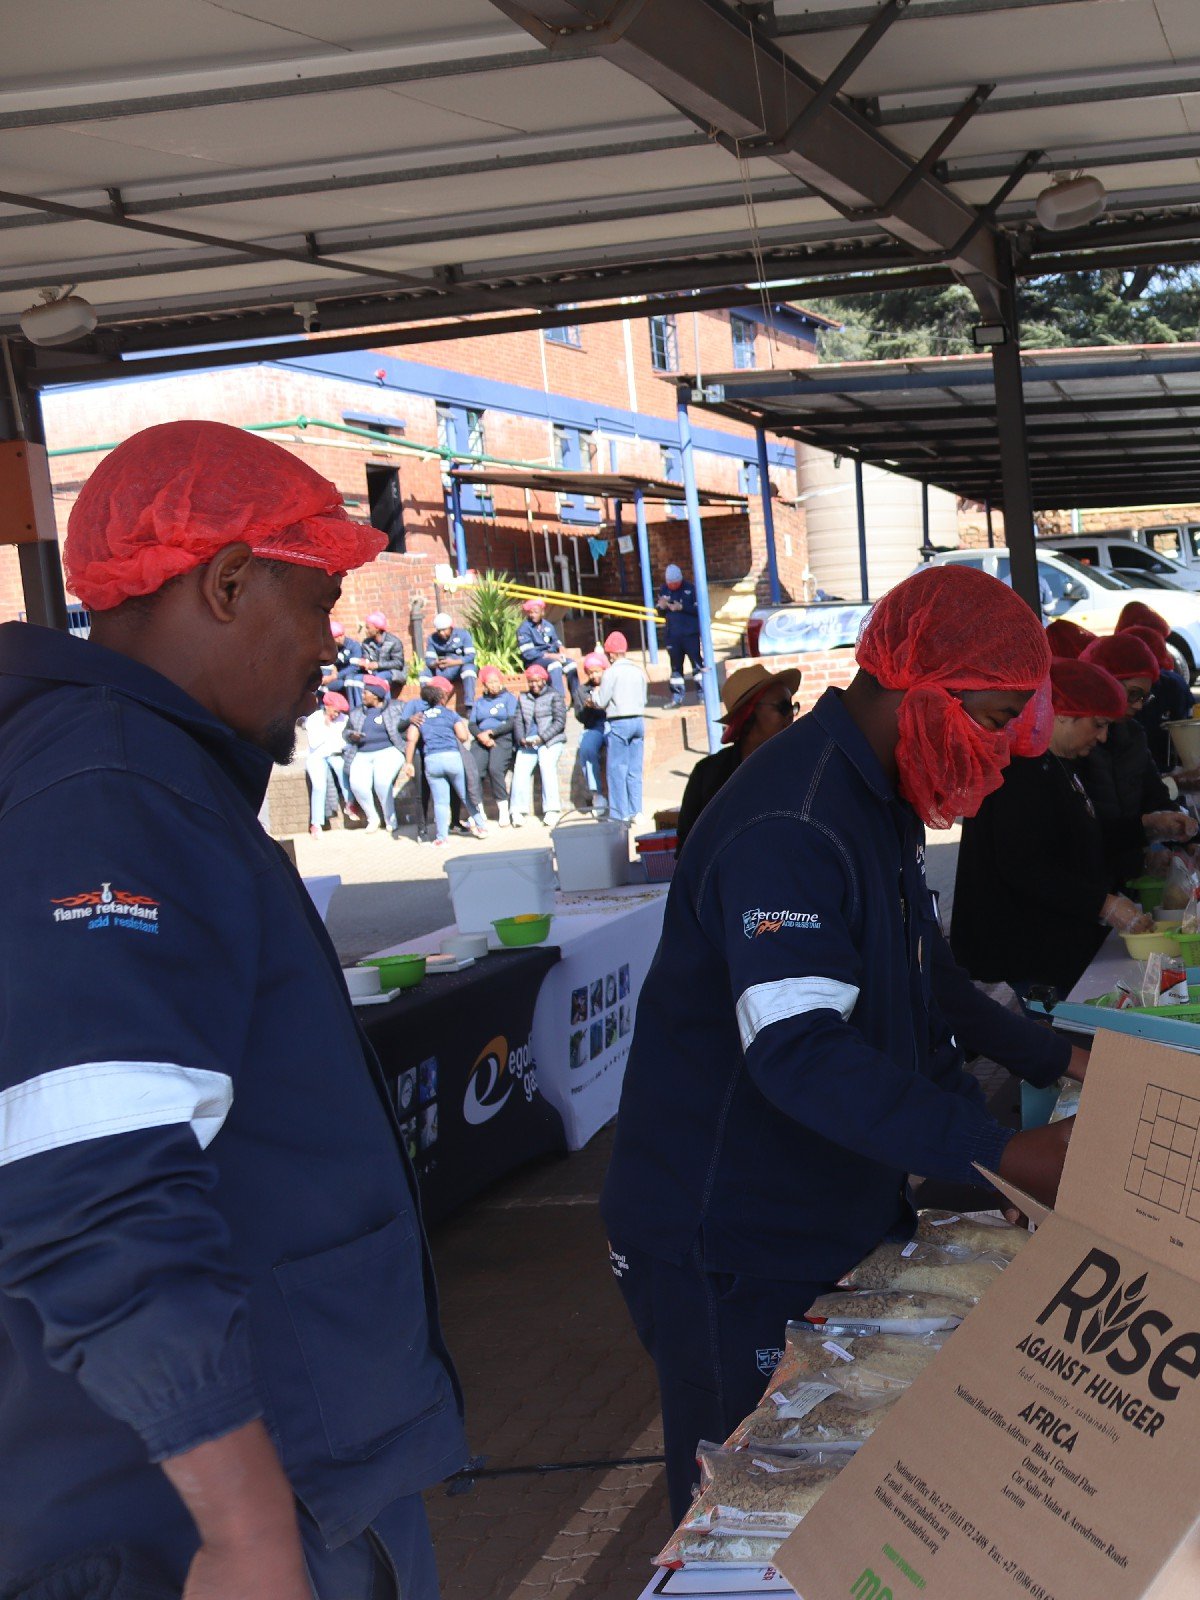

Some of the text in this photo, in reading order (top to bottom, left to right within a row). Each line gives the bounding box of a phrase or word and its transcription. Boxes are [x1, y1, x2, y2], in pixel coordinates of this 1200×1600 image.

[53, 902, 159, 922] flame retardant
[88, 915, 159, 935] acid resistant
[752, 910, 819, 922] zeroflame
[1016, 1332, 1165, 1438] AGAINST HUNGER
[1018, 1366, 1120, 1444] food community sustainability
[954, 1384, 978, 1406] National
[975, 1399, 992, 1416] Head
[989, 1411, 1006, 1428] Office
[1032, 1442, 1050, 1462] Block
[1054, 1460, 1081, 1484] Ground
[1078, 1476, 1097, 1496] Floor
[1018, 1401, 1079, 1454] AFRICA
[1000, 1484, 1026, 1509] Aeroton
[1022, 1456, 1055, 1488] Omni Park
[894, 1460, 917, 1484] National
[914, 1479, 930, 1497] Office
[1002, 1560, 1017, 1574] +27
[1024, 1480, 1043, 1500] Sailor
[1043, 1493, 1062, 1516] Malan
[1061, 1510, 1071, 1522] &
[1068, 1517, 1106, 1550] Aerodrome
[1105, 1543, 1129, 1569] Roads
